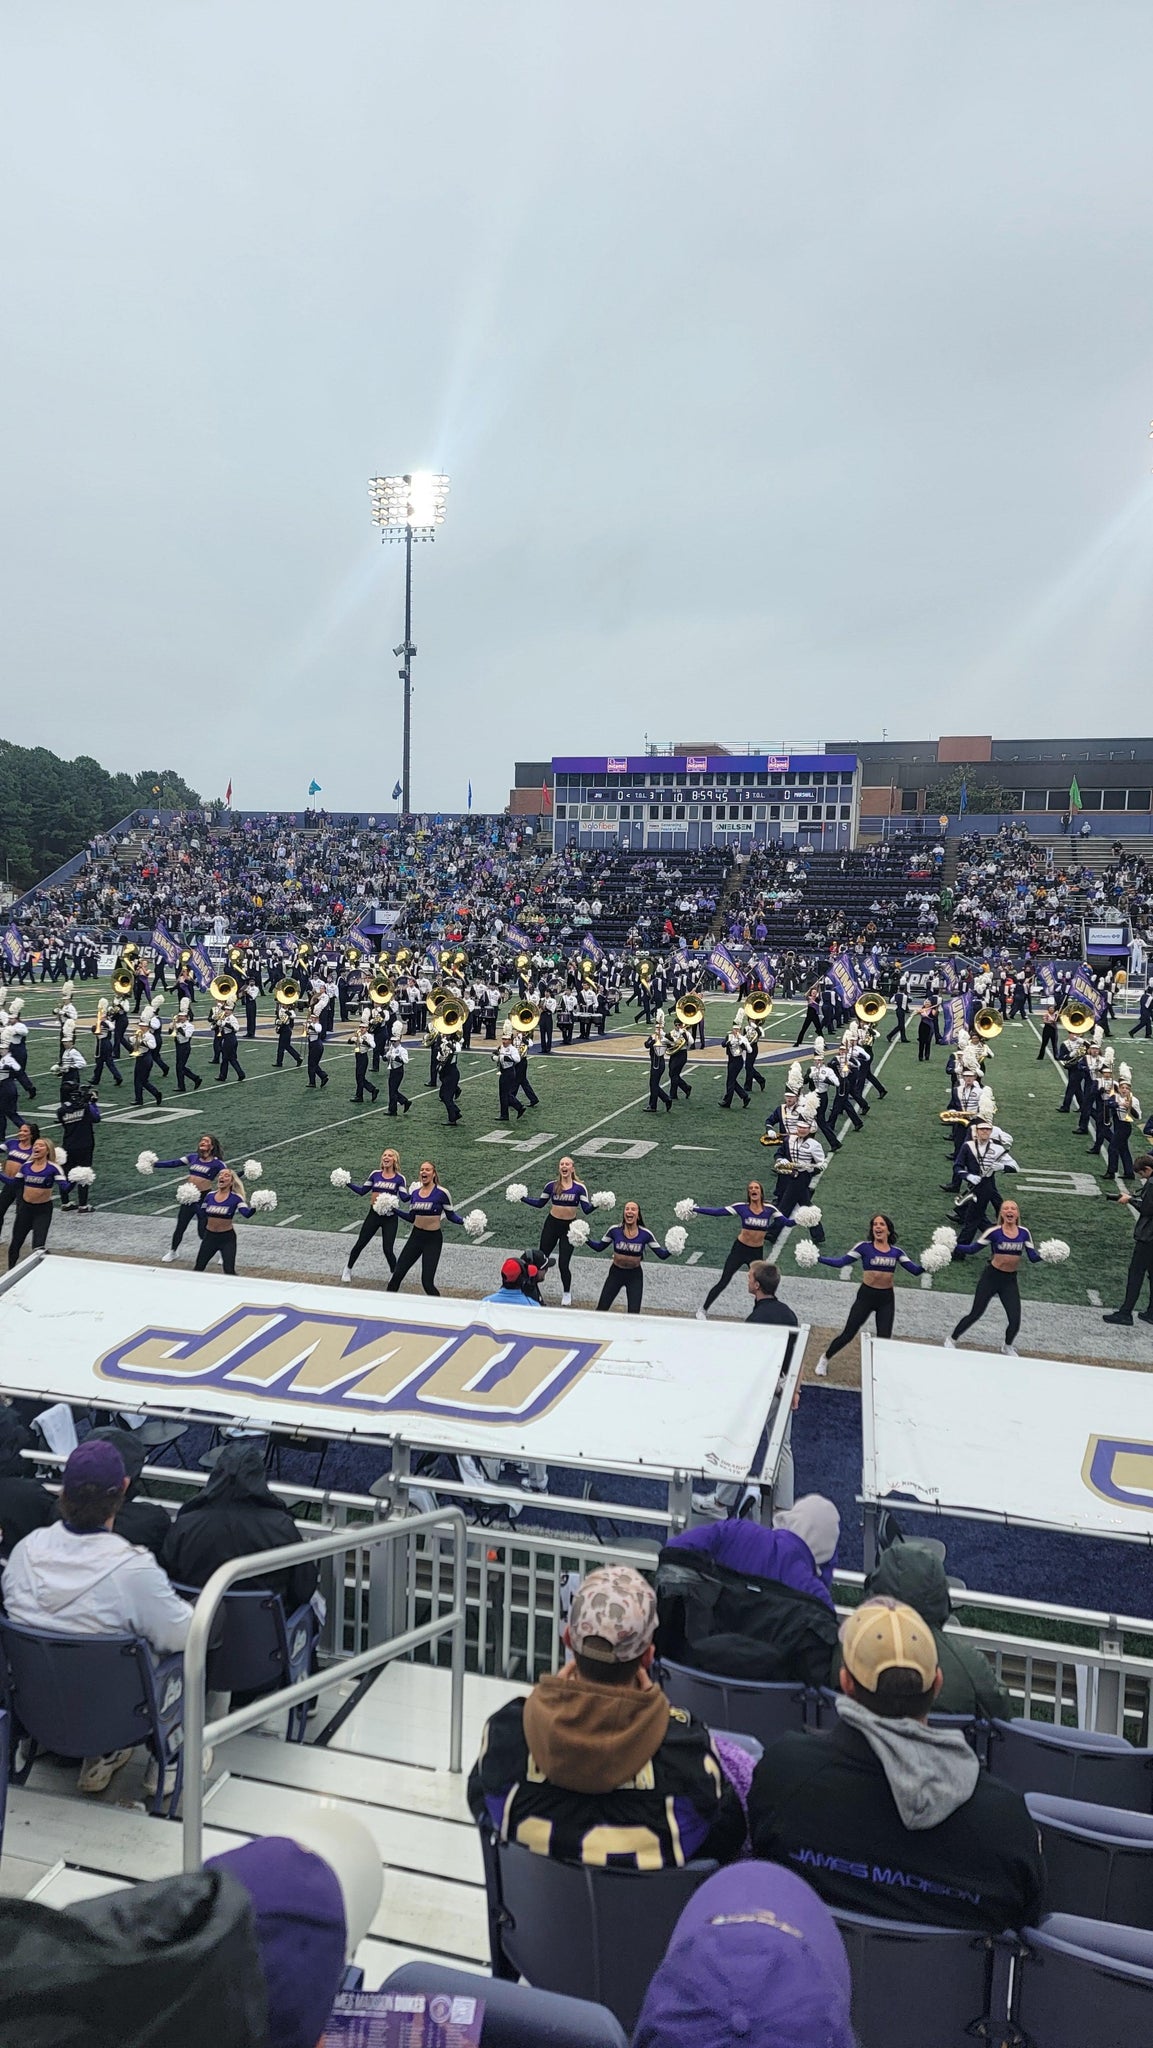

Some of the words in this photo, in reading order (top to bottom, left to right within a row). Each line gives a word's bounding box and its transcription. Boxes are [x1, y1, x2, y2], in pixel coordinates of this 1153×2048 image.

[617, 790, 623, 800] 0
[649, 791, 655, 799] 3
[673, 792, 683, 802] 10
[692, 790, 713, 800] 8:59
[715, 792, 728, 802] 45
[745, 791, 750, 799] 3
[784, 790, 790, 800] 0
[8, 1150, 31, 1160] JMU
[190, 1163, 212, 1174] JMU
[373, 1181, 397, 1190] JMU
[205, 1205, 231, 1215] JMU
[412, 1201, 434, 1210] JMU
[744, 1217, 768, 1227] JMU
[998, 1241, 1024, 1251] JMU
[870, 1255, 897, 1266] JMU
[98, 1303, 608, 1425] JMU
[788, 1848, 869, 1880] JAMES
[871, 1865, 981, 1905] MADISON
